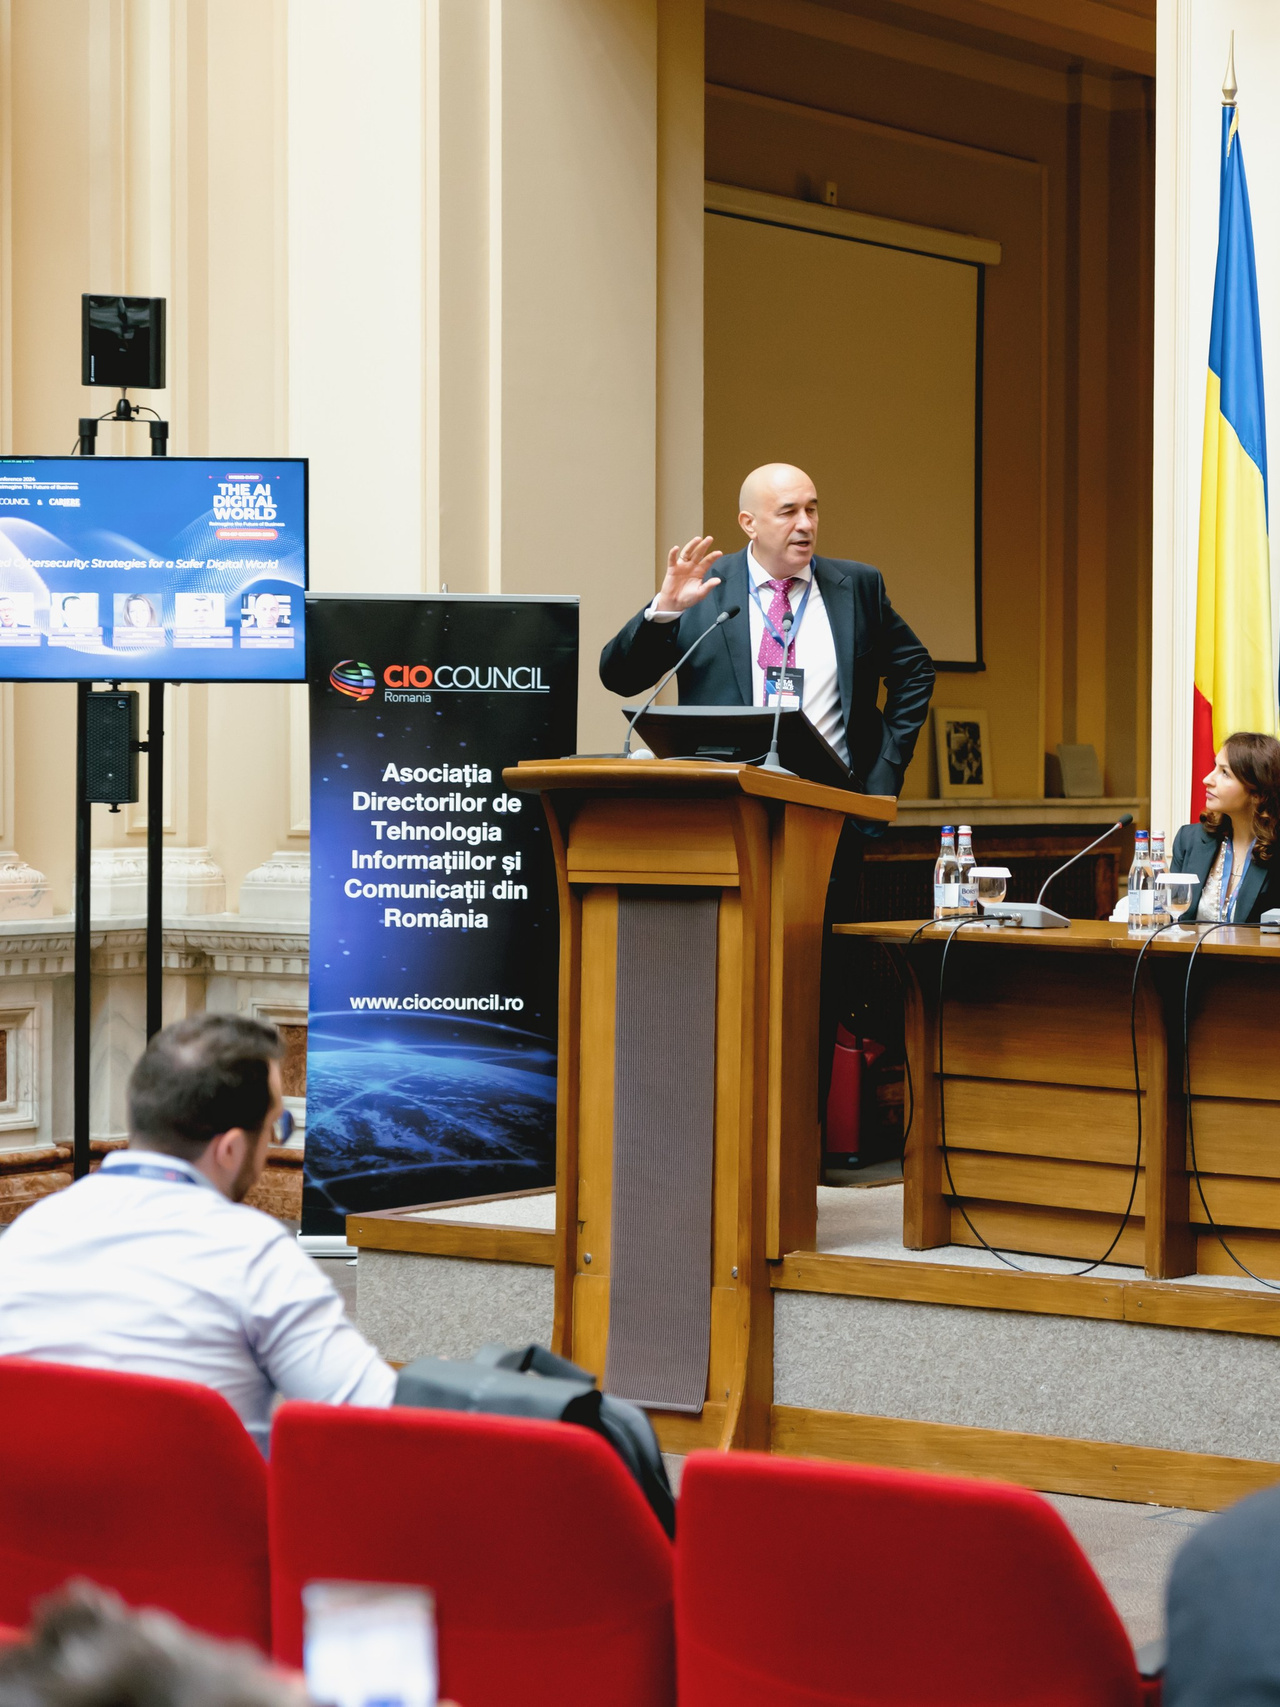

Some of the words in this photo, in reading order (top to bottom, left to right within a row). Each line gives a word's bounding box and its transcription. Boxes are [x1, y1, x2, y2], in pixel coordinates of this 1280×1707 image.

[217, 483, 251, 496] THE
[253, 484, 271, 496] AI
[213, 495, 278, 509] DIGITAL
[213, 507, 277, 520] WORLD
[91, 558, 147, 570] Strategies
[148, 558, 164, 569] for
[175, 559, 205, 569] Safer
[206, 559, 244, 570] Digital
[245, 560, 279, 569] World
[384, 691, 431, 703] Romania
[382, 762, 492, 788] Asociația
[352, 791, 487, 812] Directorilor
[492, 793, 522, 813] de
[371, 820, 502, 846] Tehnologia
[352, 850, 496, 875] Informațiilor
[502, 851, 522, 876] și
[344, 878, 485, 904] Comunicații
[492, 880, 528, 900] din
[384, 908, 488, 928] România
[349, 993, 524, 1011] www.ciocouncil.ro
